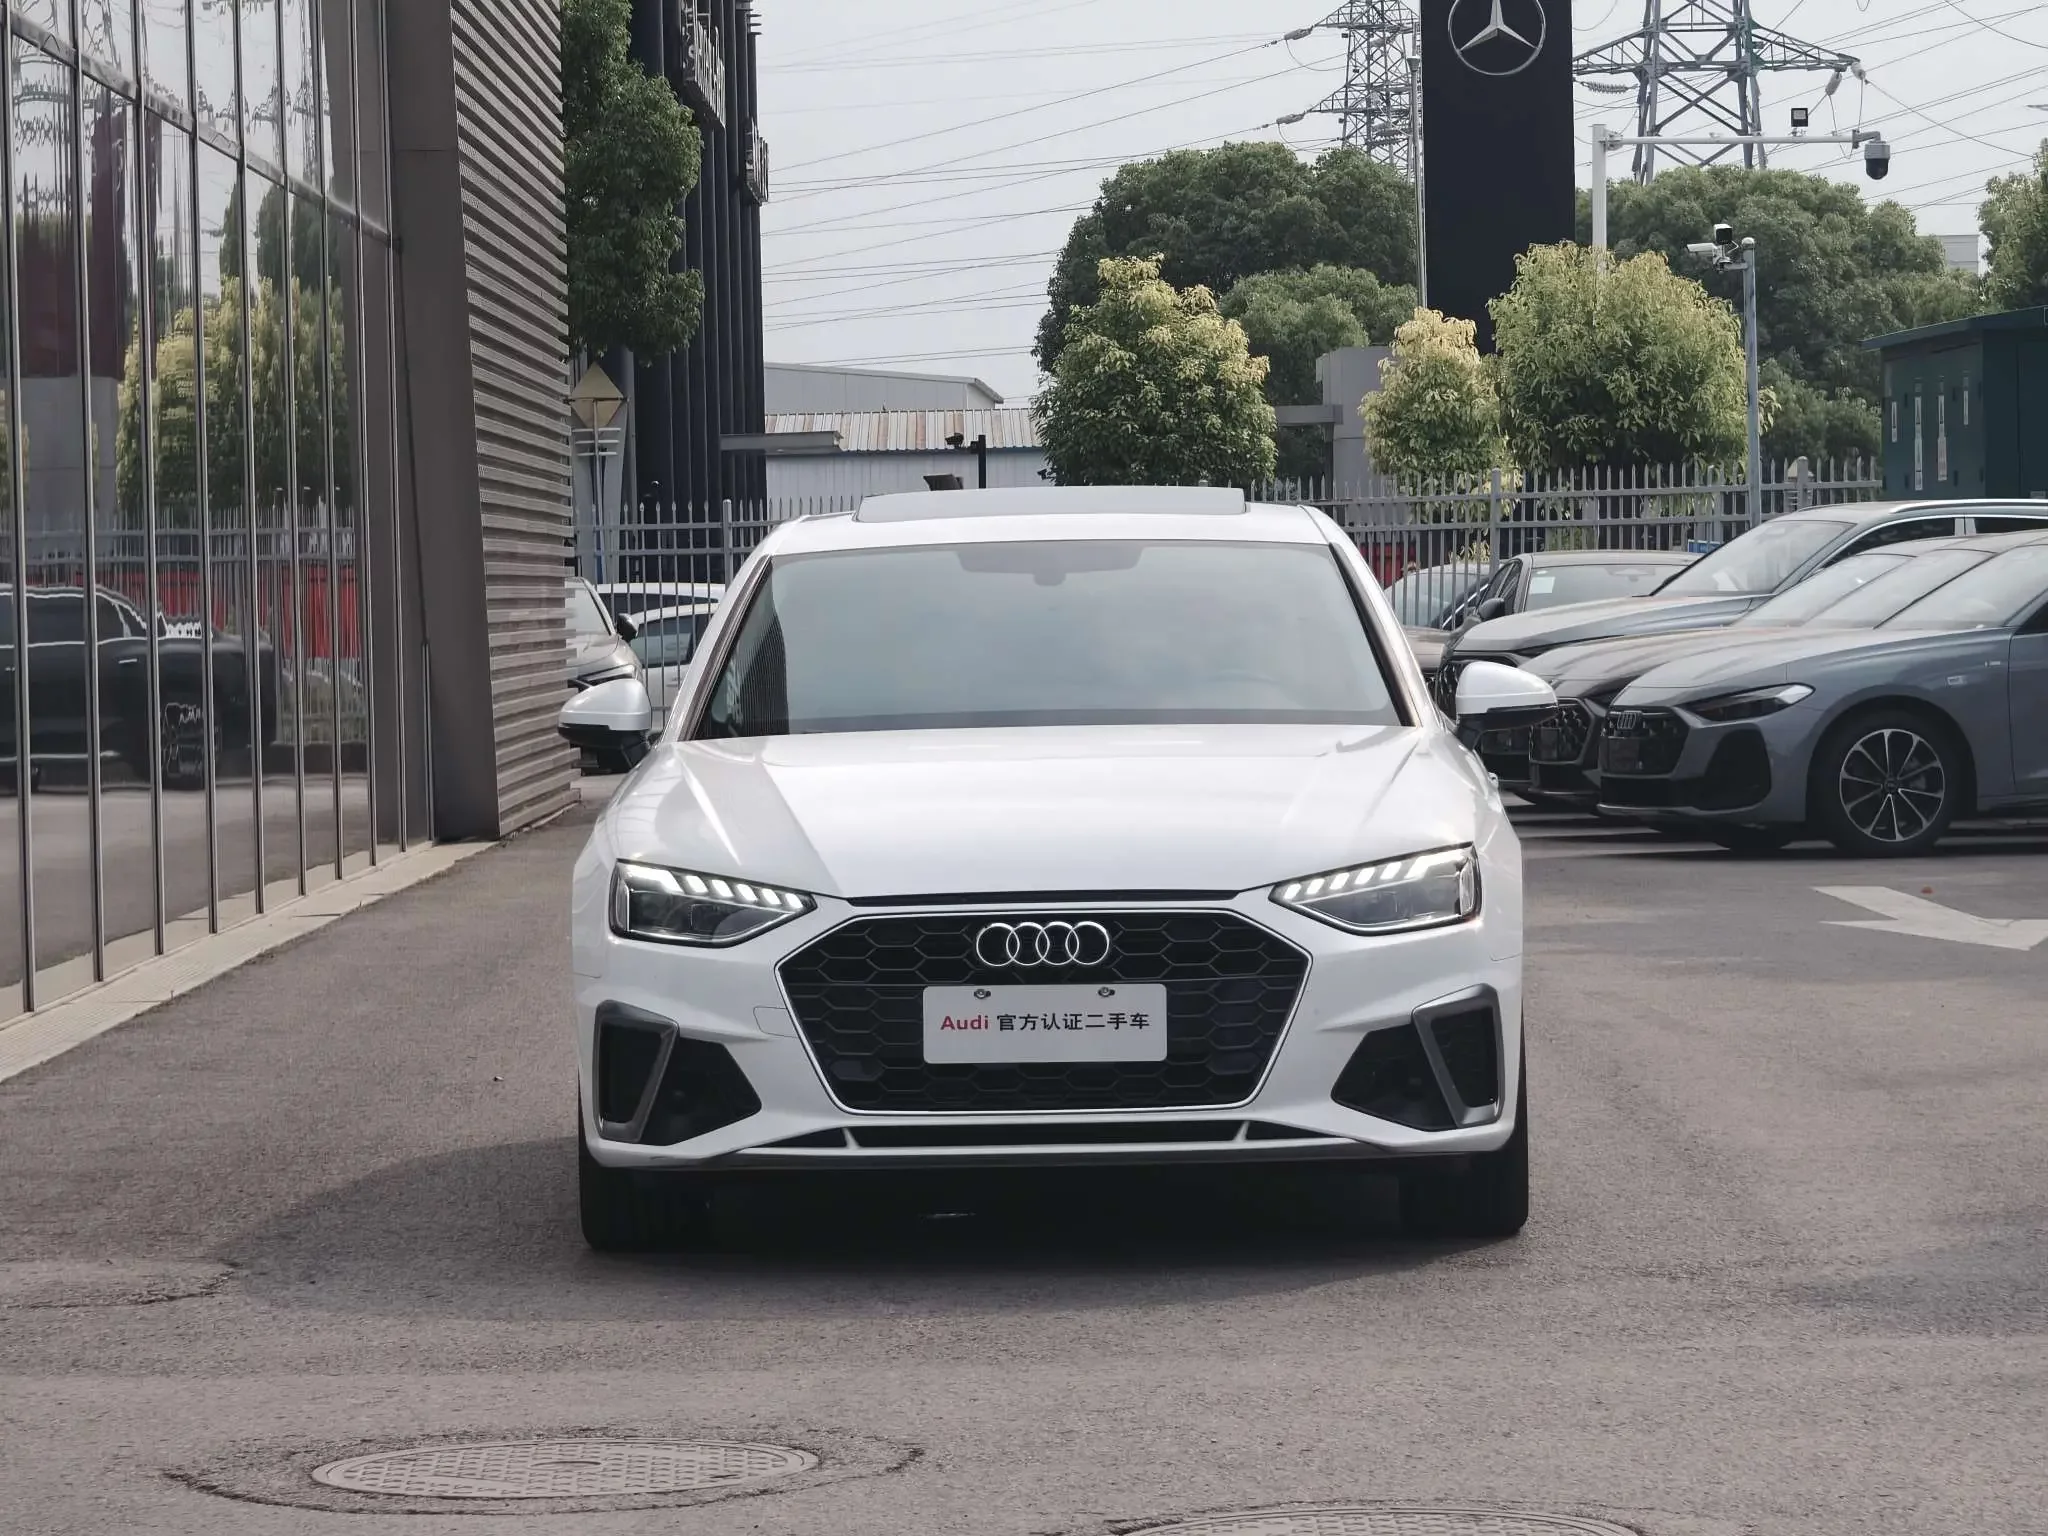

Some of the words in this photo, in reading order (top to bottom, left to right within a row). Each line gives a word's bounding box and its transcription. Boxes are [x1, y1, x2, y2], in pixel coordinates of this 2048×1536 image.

[940, 1014, 989, 1031] Audi
[996, 1012, 1150, 1031] 官方认证二手车
